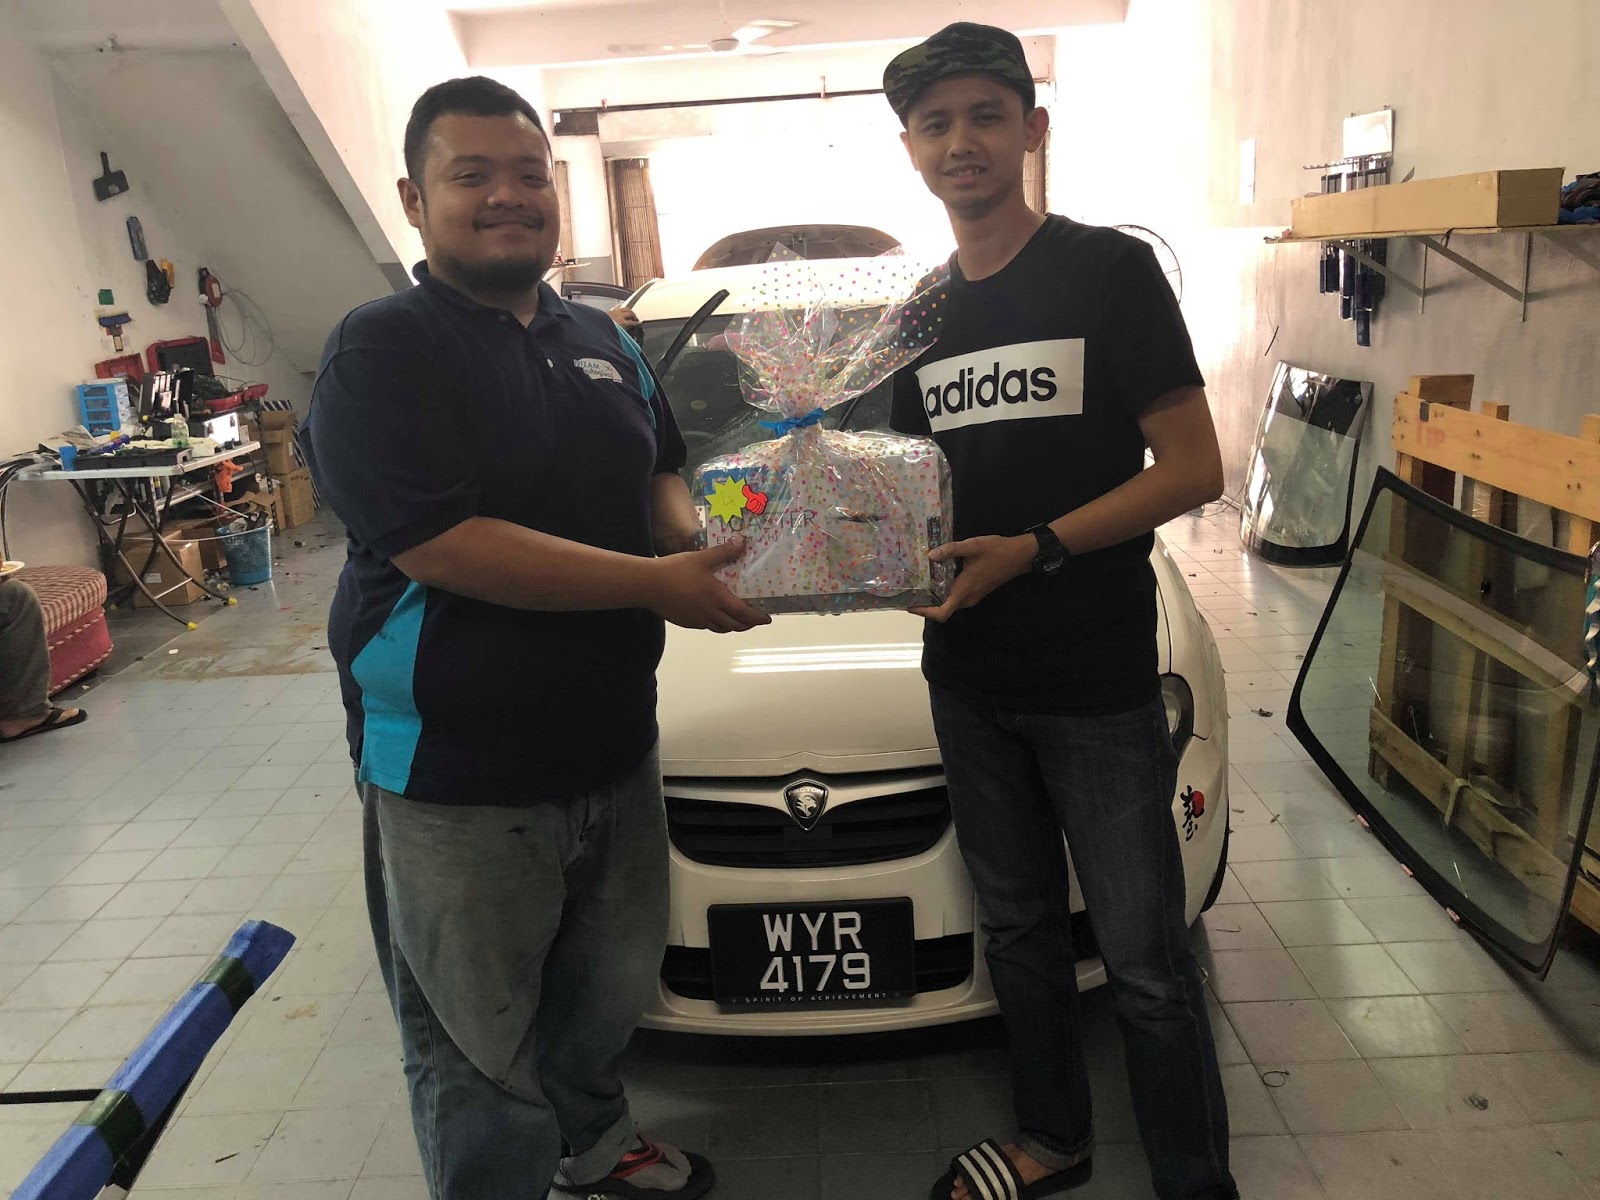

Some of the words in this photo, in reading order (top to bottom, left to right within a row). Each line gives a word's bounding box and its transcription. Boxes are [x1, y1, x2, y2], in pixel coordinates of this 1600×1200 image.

[925, 361, 1058, 419] adidas
[788, 787, 824, 795] PROTON
[762, 911, 863, 952] WYR
[760, 952, 871, 992] 4179
[811, 992, 887, 1001] ACHIEVEMENT
